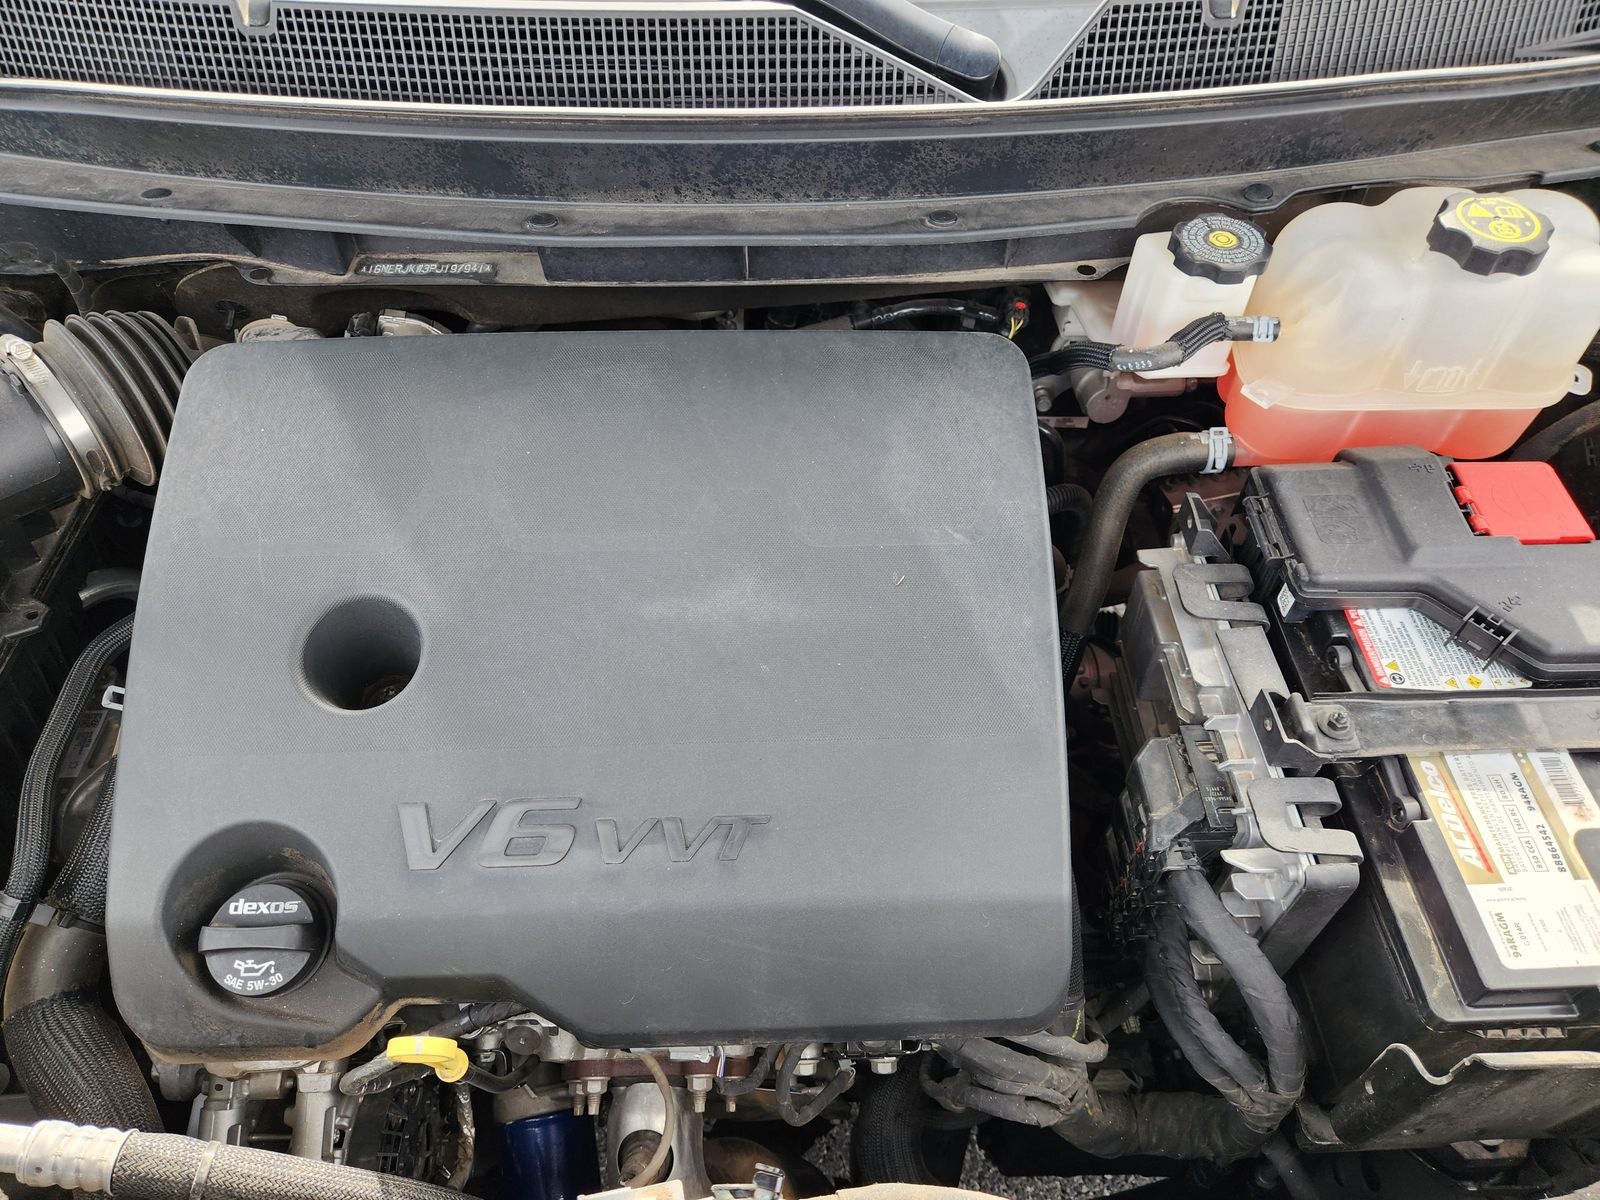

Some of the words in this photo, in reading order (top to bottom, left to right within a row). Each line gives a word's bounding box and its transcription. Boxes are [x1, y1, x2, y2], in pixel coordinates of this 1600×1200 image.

[1508, 772, 1535, 811] 94RAGM
[398, 796, 584, 871] V6
[595, 814, 772, 865] VVT
[1420, 760, 1484, 871] ACDelco
[1535, 823, 1567, 872] 88864542
[228, 898, 299, 915] dexos
[1494, 912, 1523, 958] 94RAGM
[224, 974, 243, 990] SAE
[246, 972, 283, 991] 5W-30
